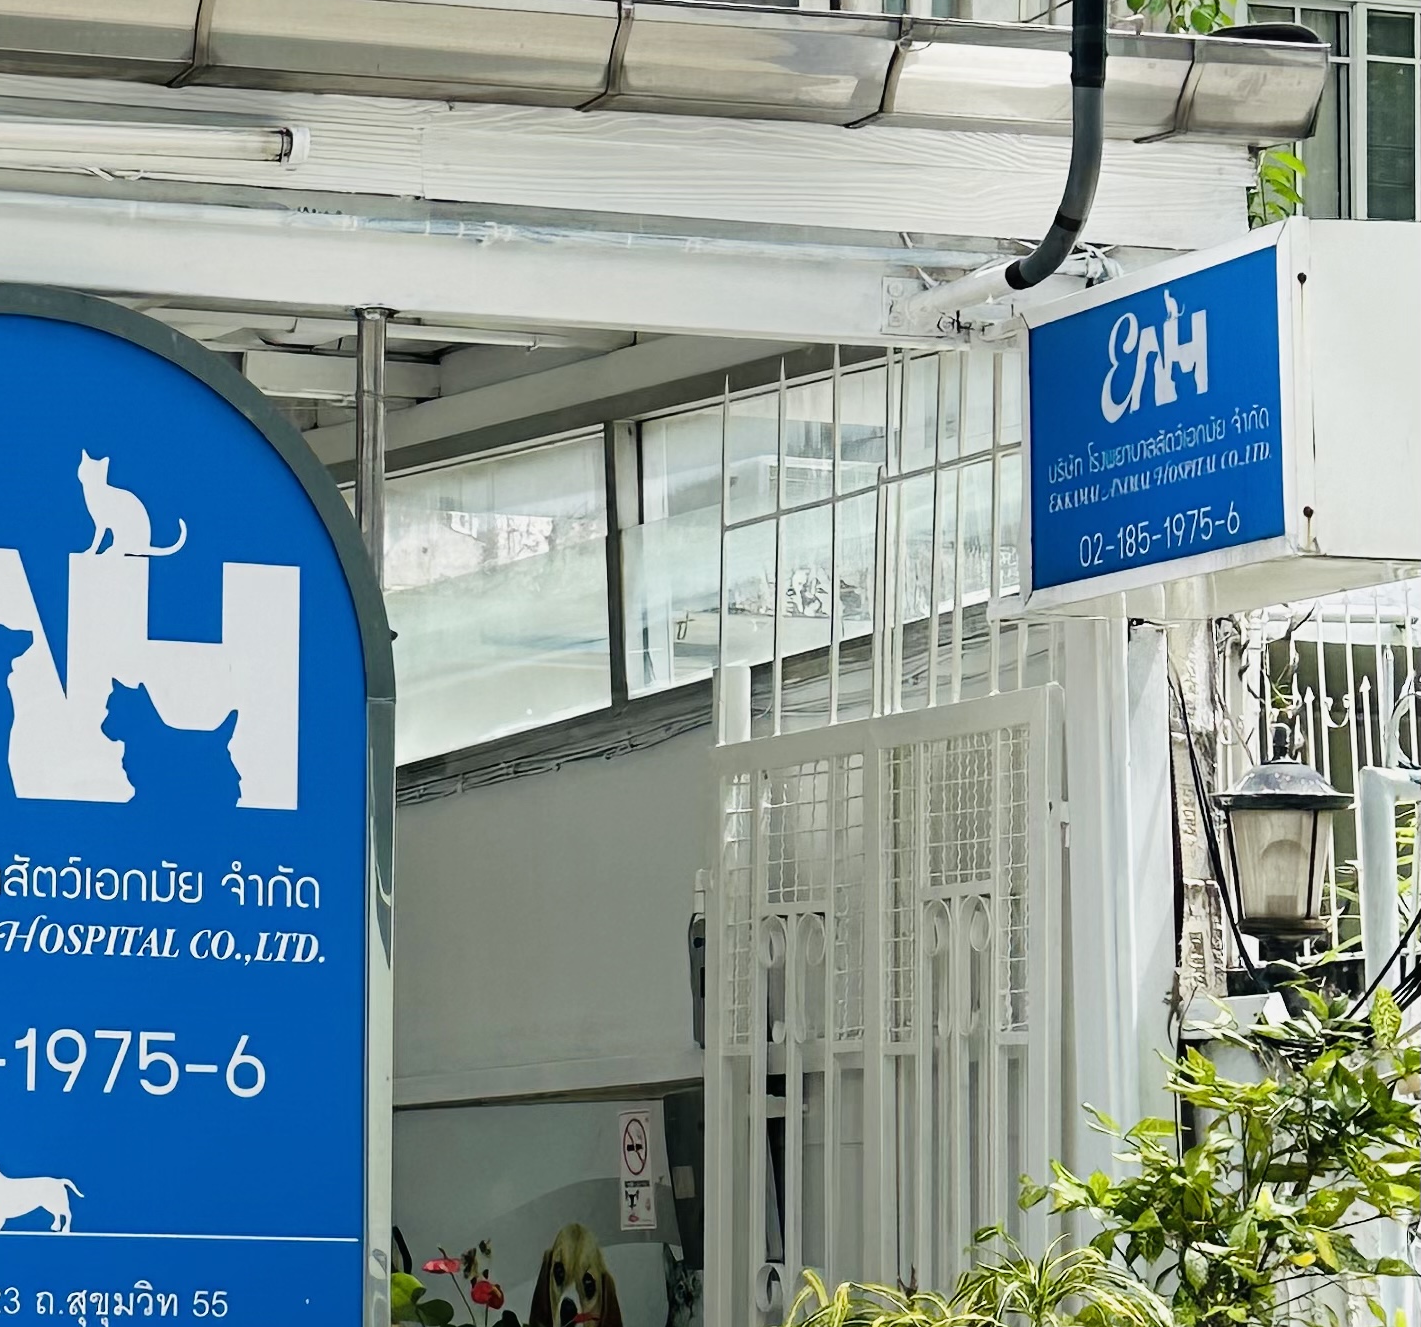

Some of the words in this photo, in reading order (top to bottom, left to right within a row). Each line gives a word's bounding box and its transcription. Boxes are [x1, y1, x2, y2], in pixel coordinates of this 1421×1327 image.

[1048, 453, 1083, 484] บริษัท
[1231, 403, 1270, 435] จำกัด
[1078, 500, 1241, 568] 02-185-1975-6
[221, 860, 321, 910] จำกัด
[192, 1289, 229, 1319] 55
